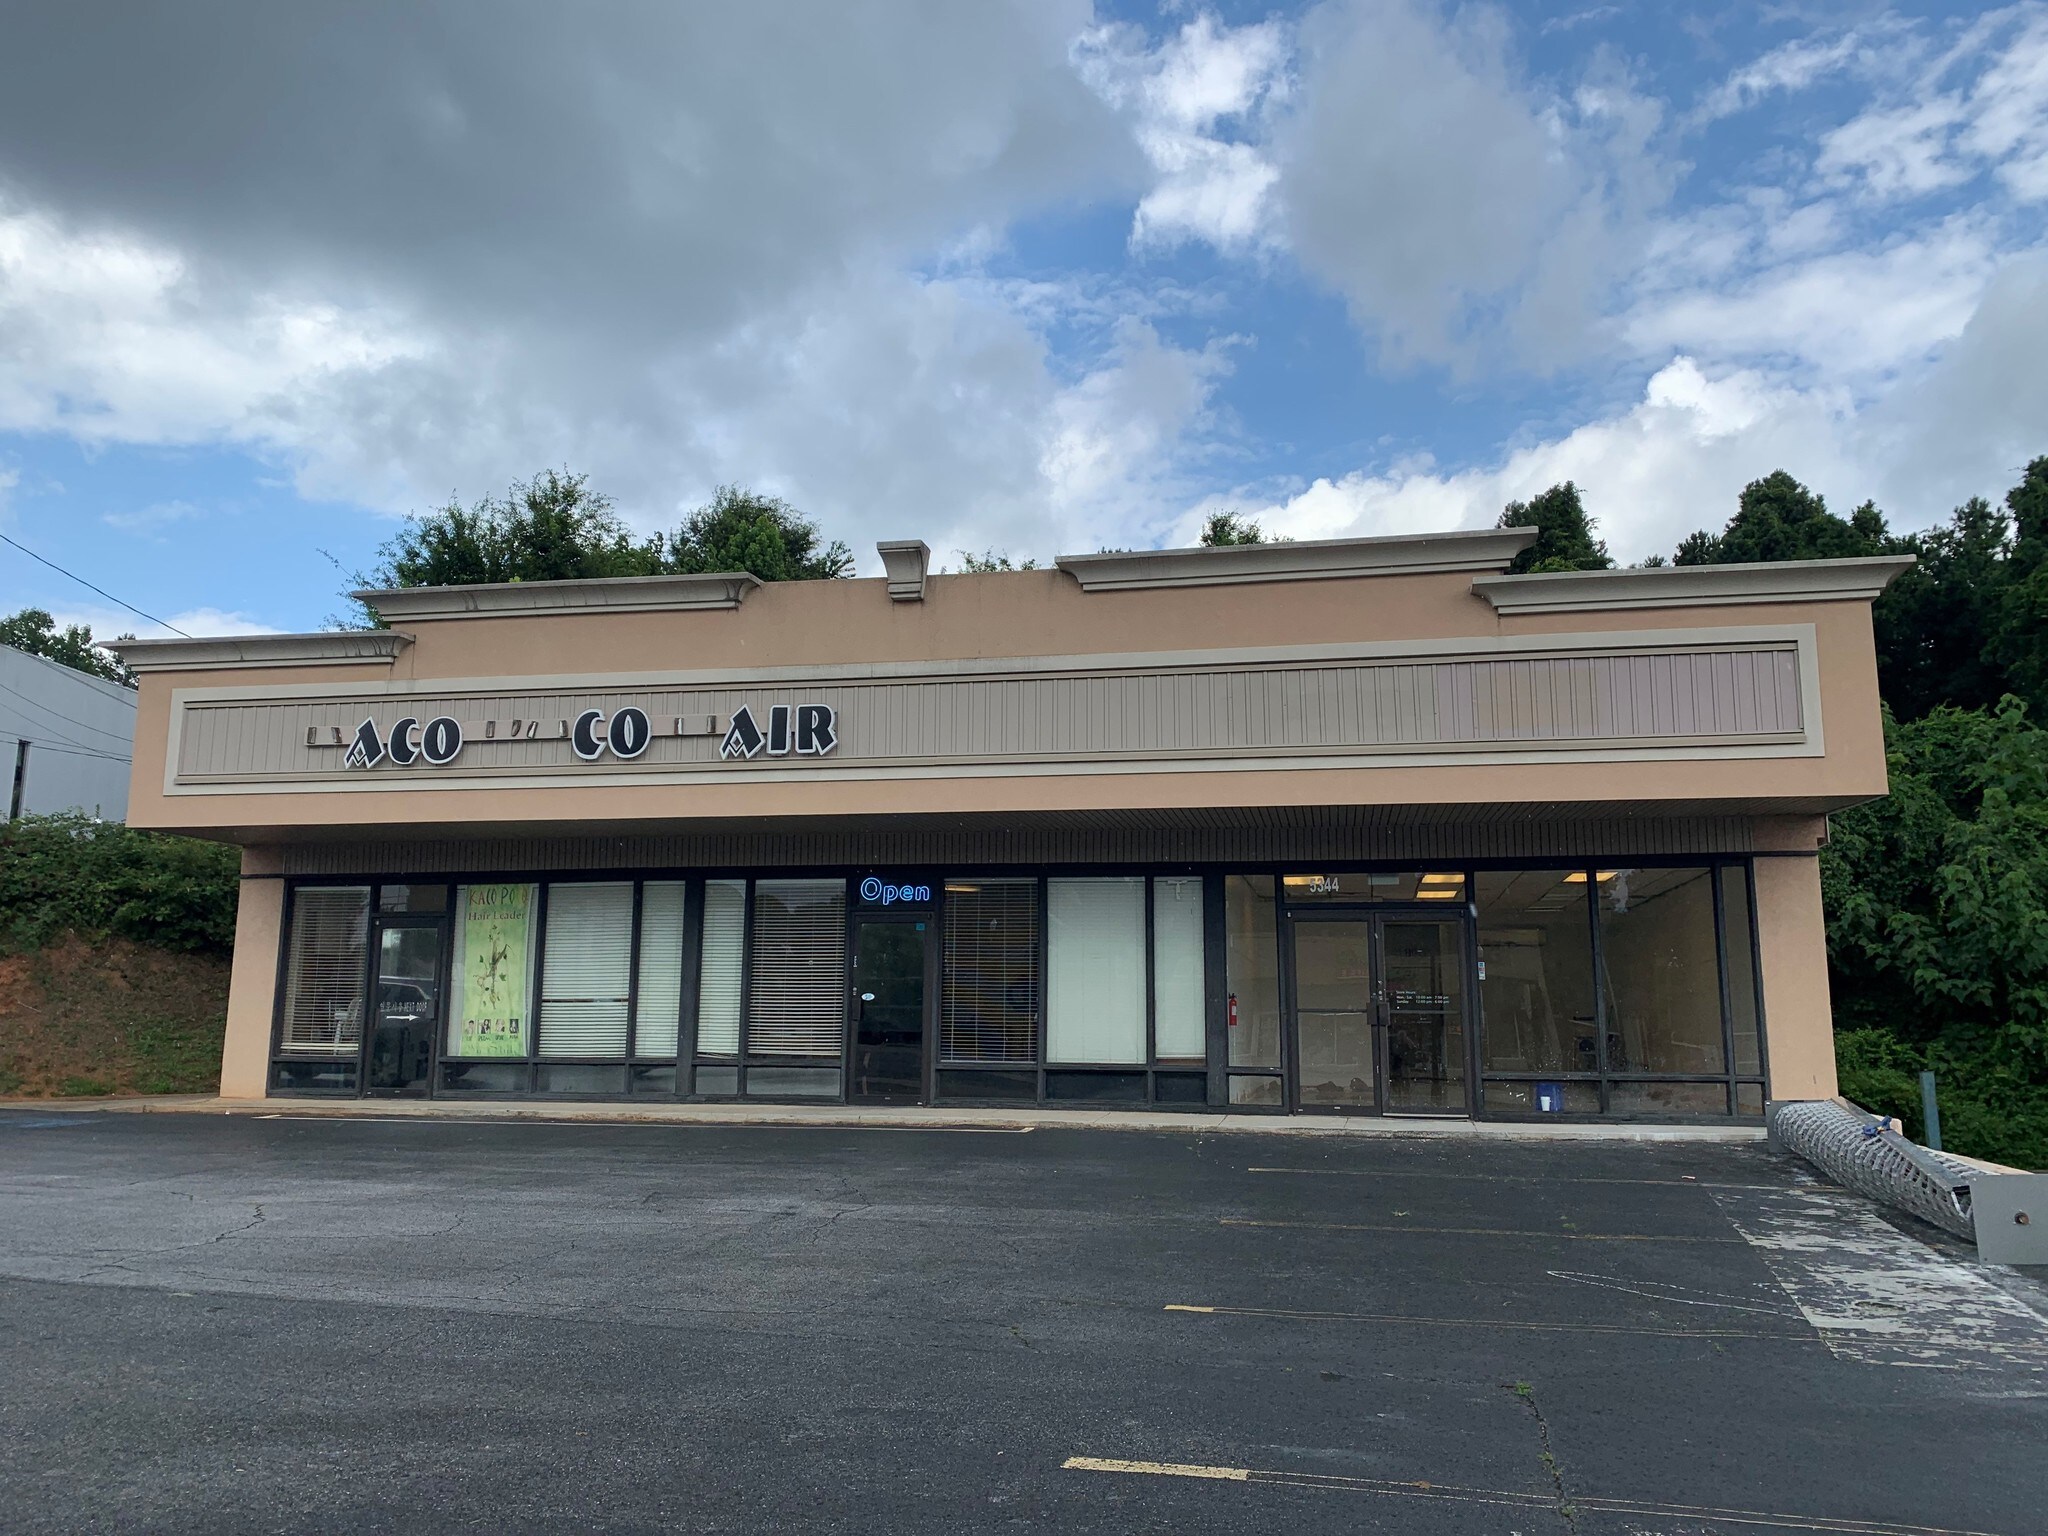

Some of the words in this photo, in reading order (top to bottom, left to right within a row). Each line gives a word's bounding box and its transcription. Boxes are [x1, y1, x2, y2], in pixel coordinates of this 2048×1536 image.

[344, 716, 463, 769] ACO
[572, 706, 651, 760] CO
[719, 704, 838, 760] AIR
[860, 877, 930, 905] Open
[1310, 877, 1339, 893] 5344
[468, 911, 490, 921] Hair
[493, 910, 526, 920] Leader
